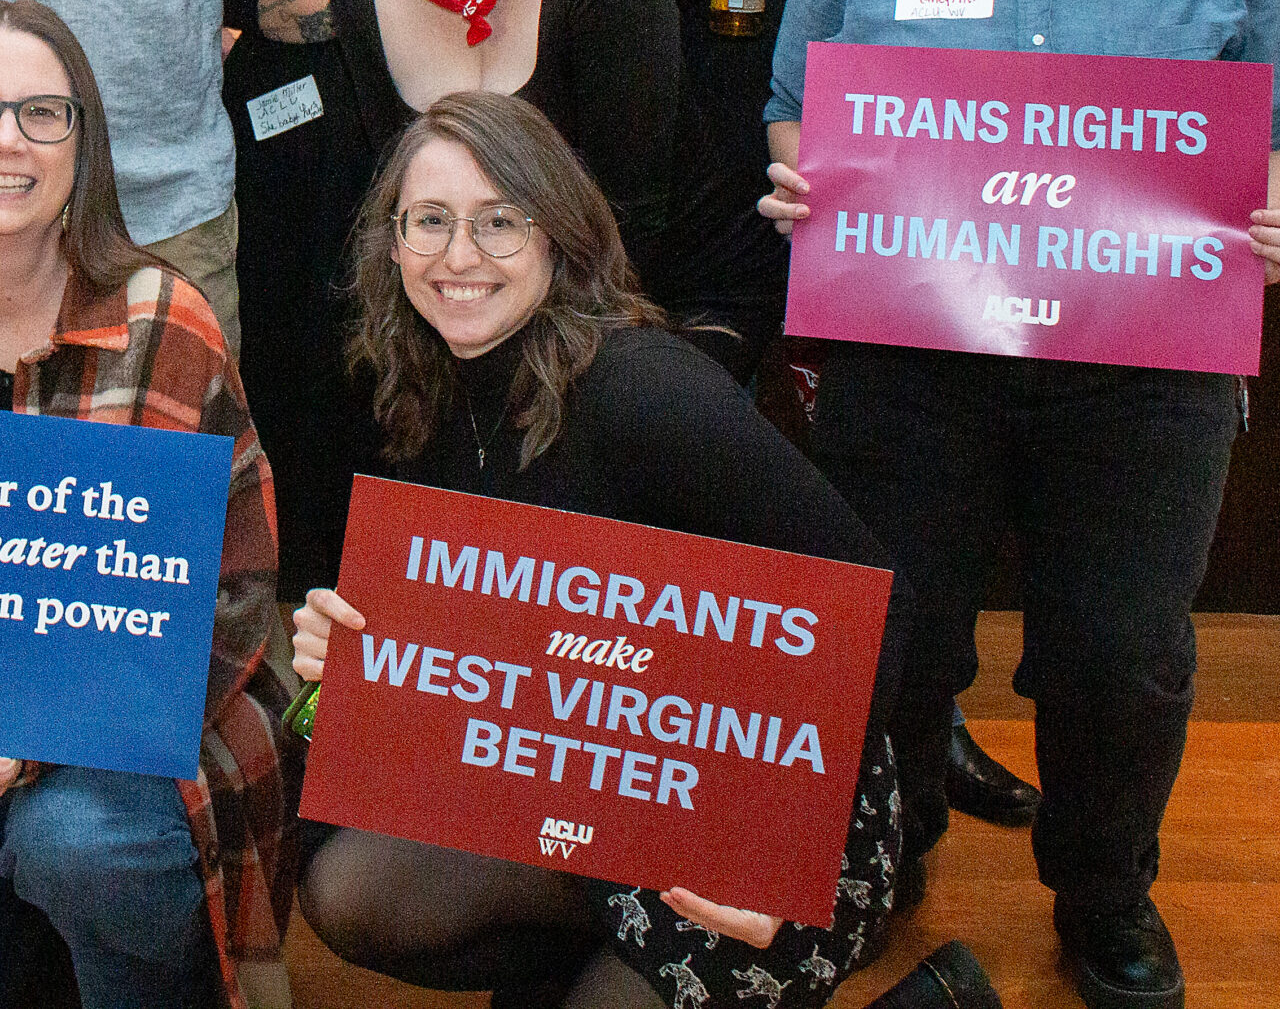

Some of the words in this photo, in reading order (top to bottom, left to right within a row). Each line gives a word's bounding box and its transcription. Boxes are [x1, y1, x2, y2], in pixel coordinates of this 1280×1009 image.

[845, 93, 1009, 144] TRANS
[1023, 103, 1209, 156] RIGHTS
[981, 170, 1076, 209] are
[835, 211, 1020, 267] HUMAN
[1036, 226, 1224, 281] RIGHTS
[982, 295, 1061, 327] ACLU
[26, 476, 78, 514] of
[81, 481, 150, 523] the
[95, 539, 191, 585] than
[34, 596, 170, 638] power
[405, 536, 820, 657] IMMIGRANTS
[546, 629, 655, 673] make
[361, 634, 532, 710] WEST
[547, 672, 826, 775] VIRGINIA
[461, 718, 700, 811] BETTER
[538, 837, 578, 860] WV
[540, 817, 594, 845] ACLU
